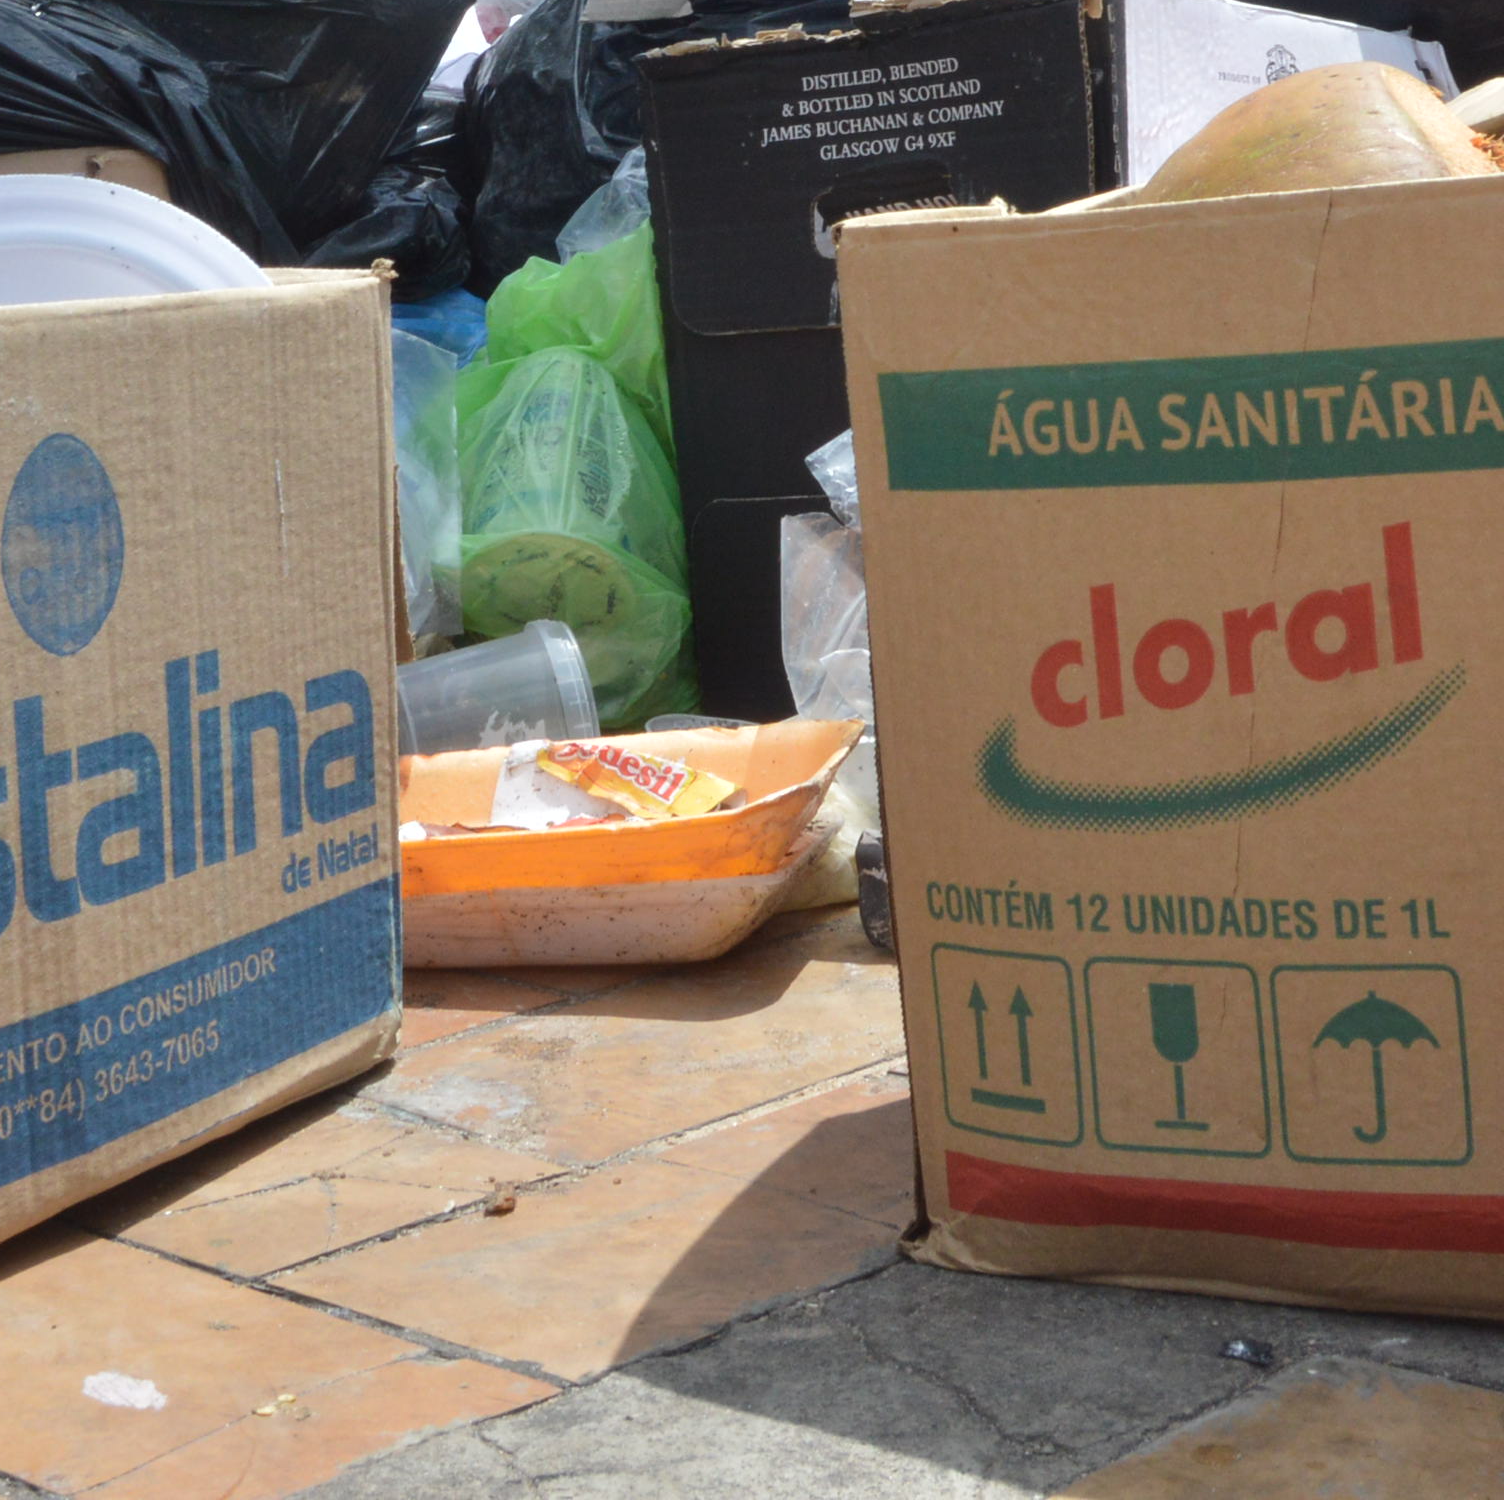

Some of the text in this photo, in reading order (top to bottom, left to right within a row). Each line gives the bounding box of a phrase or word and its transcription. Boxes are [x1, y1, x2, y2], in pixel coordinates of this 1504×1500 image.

[781, 78, 981, 118] & BOTTLED IN SCOTLAND
[801, 57, 959, 92] DISTILLED, BLENDED
[761, 100, 1005, 147] JAMES BUCHANAN & COMPANY
[819, 131, 957, 161] GLASGOW G4 9XF
[989, 388, 1145, 458] ÁGUA
[1029, 520, 1424, 729] cloral
[280, 830, 379, 895] de Natal
[925, 880, 1450, 941] CONTÉM 12 UNIDADES DE 1L
[75, 1016, 113, 1056] AO
[119, 946, 277, 1031] CONSUMIDOR
[95, 1019, 221, 1102] 3643-7065
